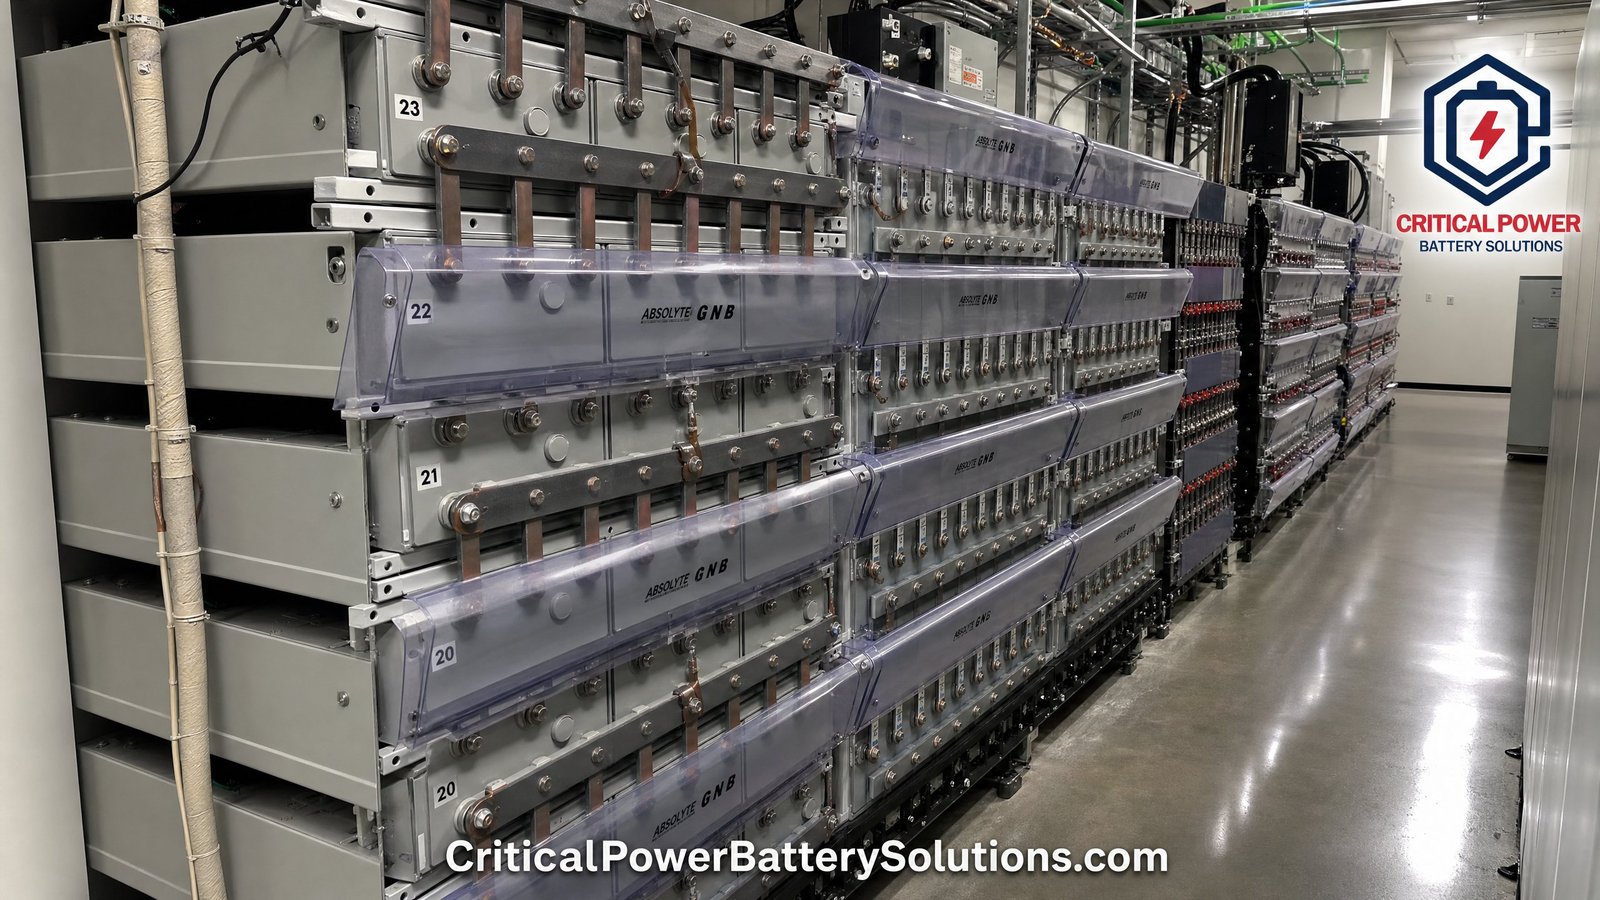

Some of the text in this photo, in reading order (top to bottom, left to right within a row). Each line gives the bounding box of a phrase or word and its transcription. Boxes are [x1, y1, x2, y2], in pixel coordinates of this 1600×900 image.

[399, 99, 420, 117] 23
[998, 140, 1016, 154] GNB
[981, 294, 998, 305] GNB
[411, 303, 432, 319] 22
[641, 304, 735, 321] ABSOLYTE GNB
[977, 451, 995, 466] GNB
[421, 468, 437, 485] 21
[645, 573, 690, 599] ABSOLYTE
[694, 558, 729, 582] GNB
[435, 646, 454, 666] 20
[437, 781, 456, 802] 20
[652, 801, 697, 839] ABSOLYTE
[701, 773, 736, 808] GNB
